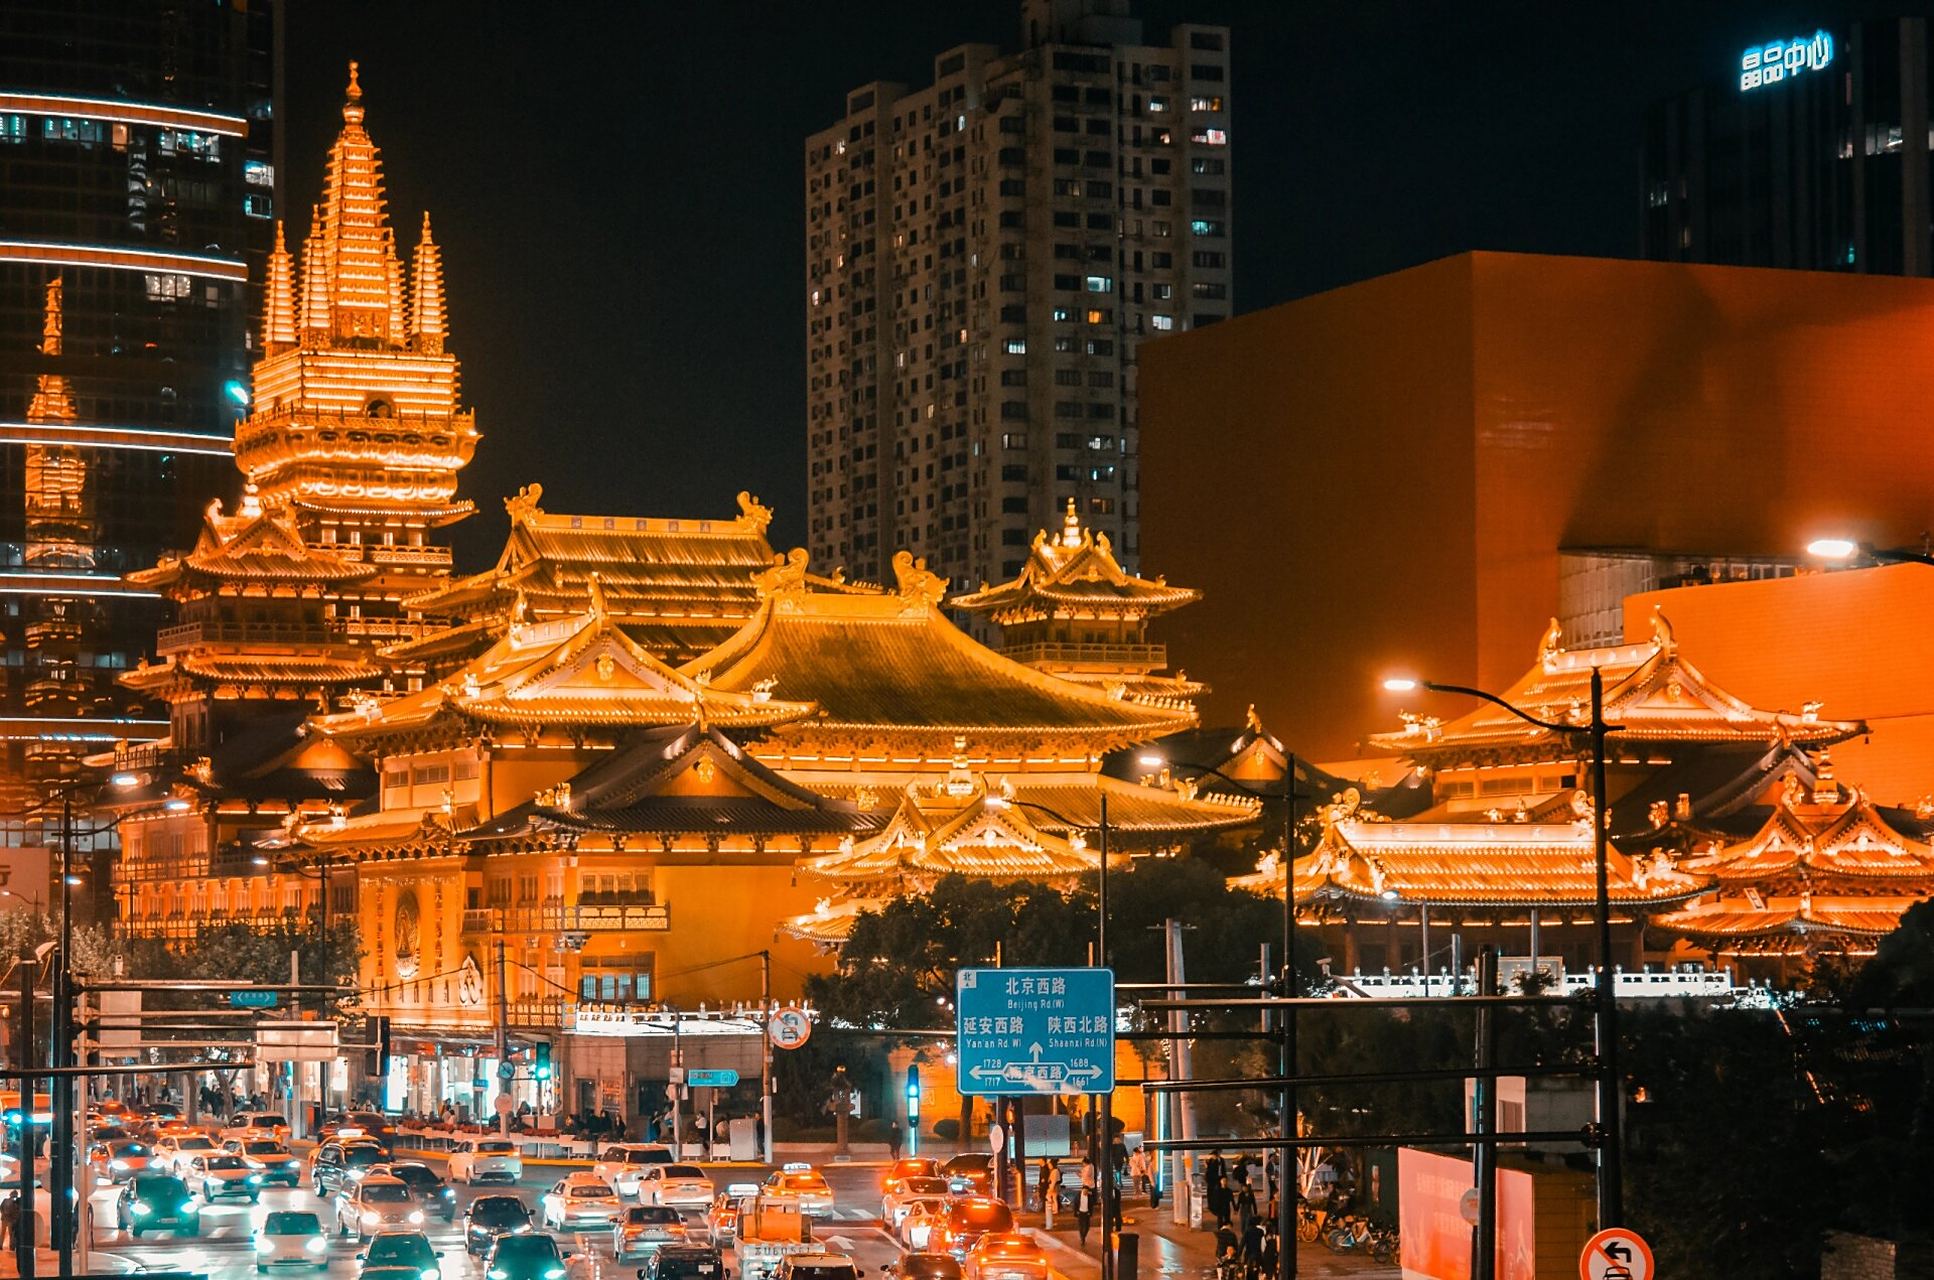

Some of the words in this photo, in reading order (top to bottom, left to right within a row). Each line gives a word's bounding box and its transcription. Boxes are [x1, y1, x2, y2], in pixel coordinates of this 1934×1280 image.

[1740, 34, 1829, 92] 晶品中心
[1006, 976, 1066, 996] 北京西路
[1007, 999, 1038, 1012] Beijing
[963, 1016, 1024, 1035] 延安西路
[1047, 1016, 1108, 1035] 陕西北路
[966, 1038, 995, 1048] Yan'an
[1048, 1038, 1083, 1048] Shaanxi
[983, 1059, 1001, 1068] 1728
[1070, 1058, 1089, 1067] 1688
[984, 1077, 1001, 1087] 1717
[1072, 1076, 1089, 1087] 1661
